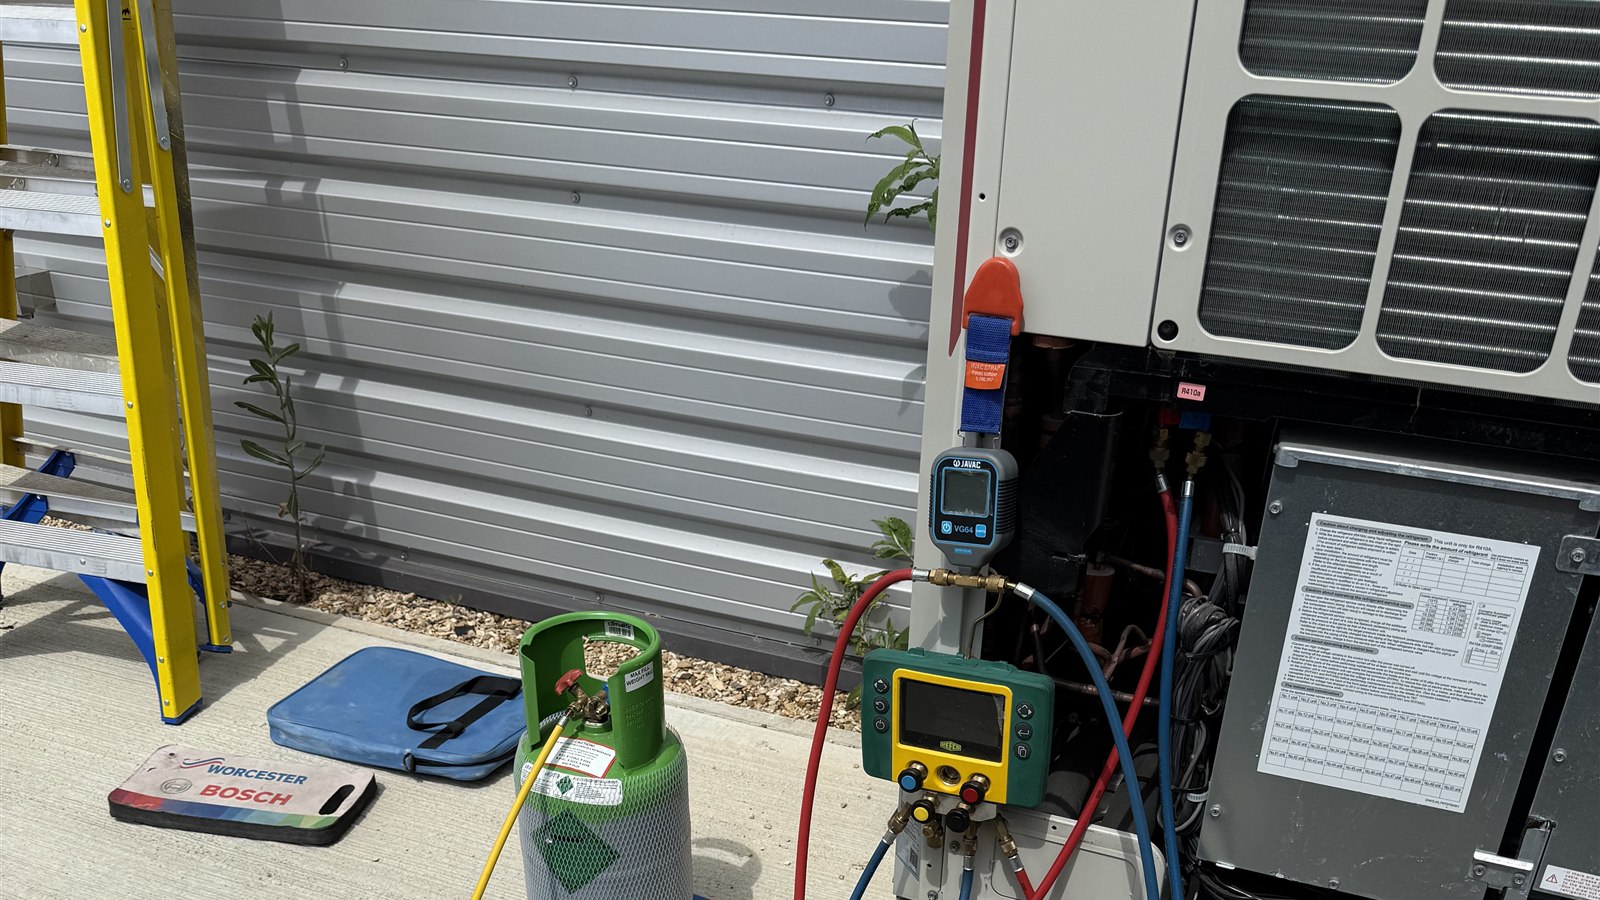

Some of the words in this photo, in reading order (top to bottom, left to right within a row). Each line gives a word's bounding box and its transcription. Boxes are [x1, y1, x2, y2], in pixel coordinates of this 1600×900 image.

[1182, 388, 1201, 397] R410a
[961, 460, 981, 469] JAVAC
[954, 525, 973, 533] VG64
[1463, 549, 1488, 557] refrigerant
[626, 674, 645, 686] WEIGHT
[207, 764, 308, 785] WORCESTER
[200, 785, 293, 805] BOSCH
